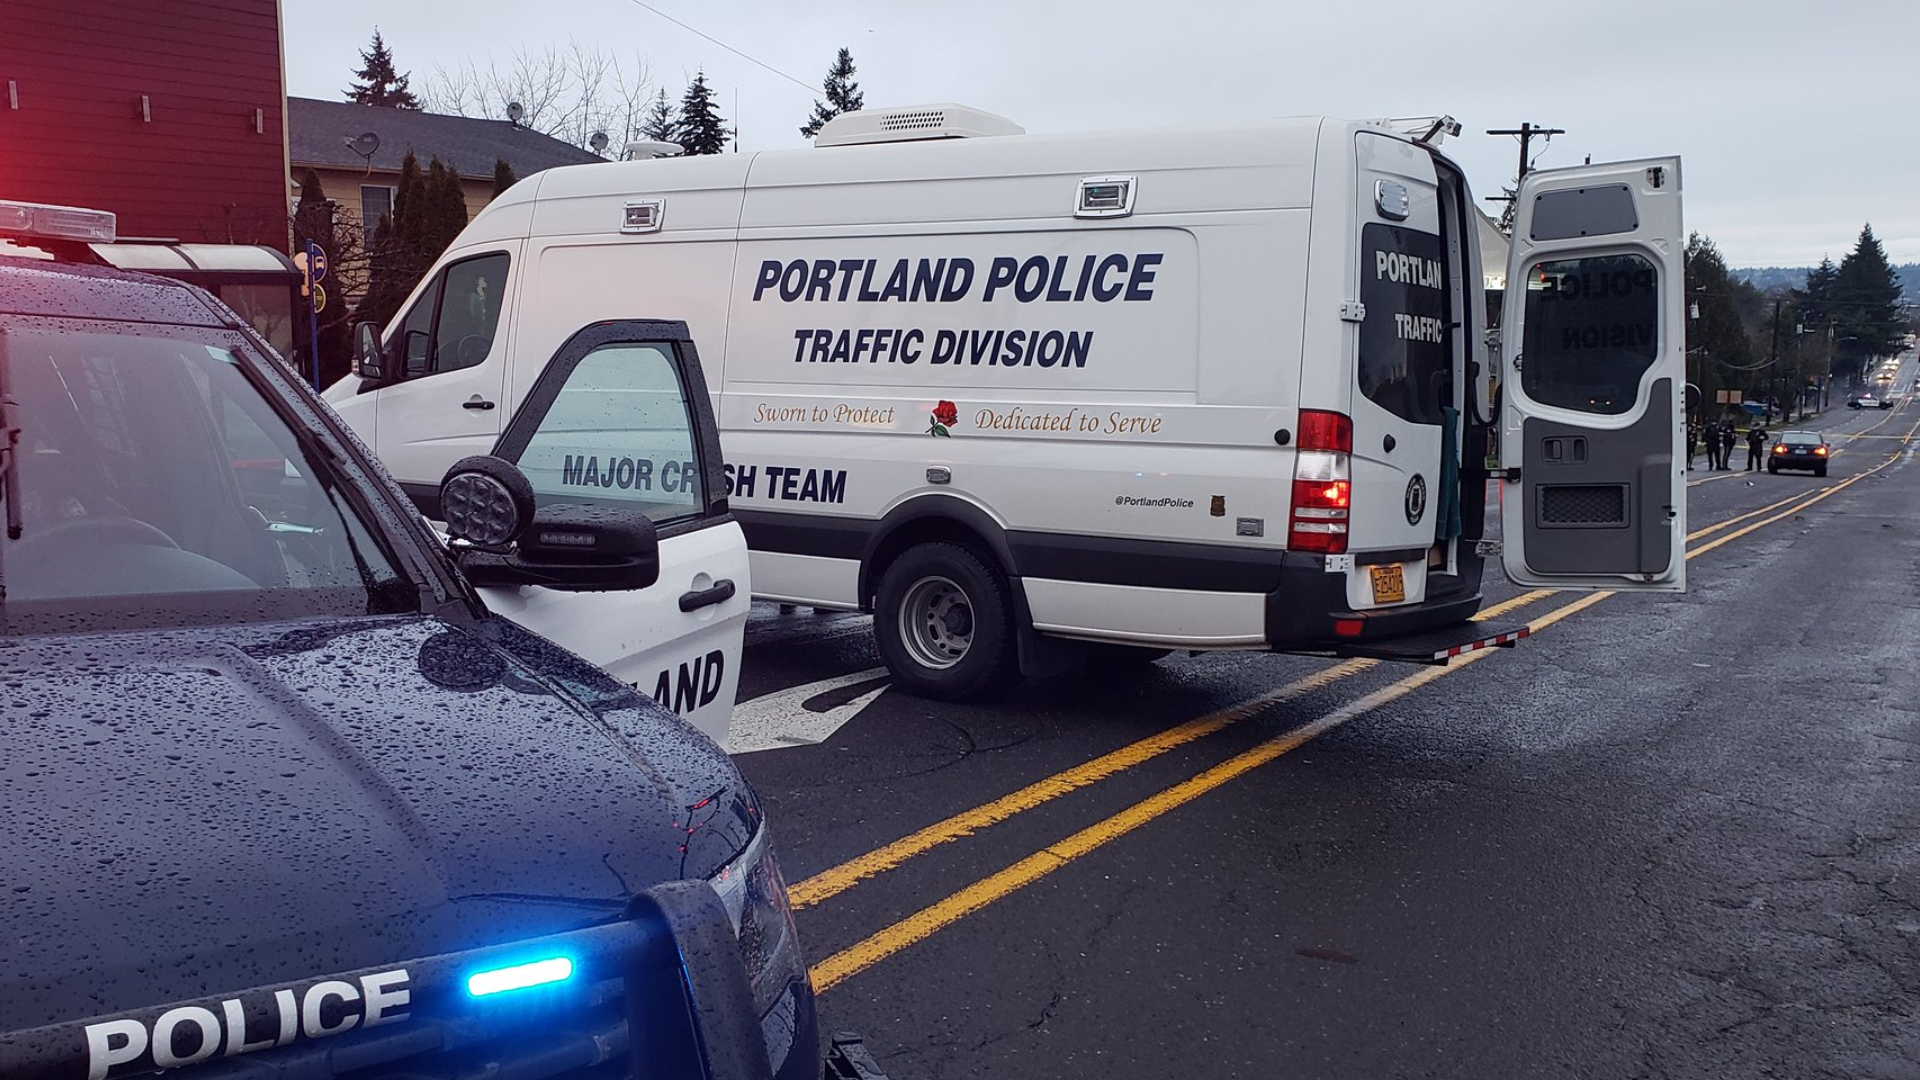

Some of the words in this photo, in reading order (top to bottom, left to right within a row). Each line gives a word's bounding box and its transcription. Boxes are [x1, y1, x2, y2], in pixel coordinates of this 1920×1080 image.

[753, 257, 975, 302] PORTLAND
[982, 253, 1164, 303] POLICE
[794, 328, 925, 365] TRAFFIC
[930, 329, 1094, 368] DIVISION
[1394, 313, 1442, 344] TRAFFIC
[753, 403, 807, 424] Sworn
[812, 404, 829, 423] to
[833, 404, 896, 425] Protect
[975, 406, 1079, 432] Dedicated
[1079, 412, 1099, 432] to
[1103, 411, 1162, 435] Serve
[562, 454, 654, 491] MAJOR
[661, 460, 757, 498] CRSH
[765, 466, 847, 504] TEAM
[1115, 496, 1194, 508] @PortlandPolice
[629, 649, 725, 716] AND
[84, 968, 412, 1080] POLICE
